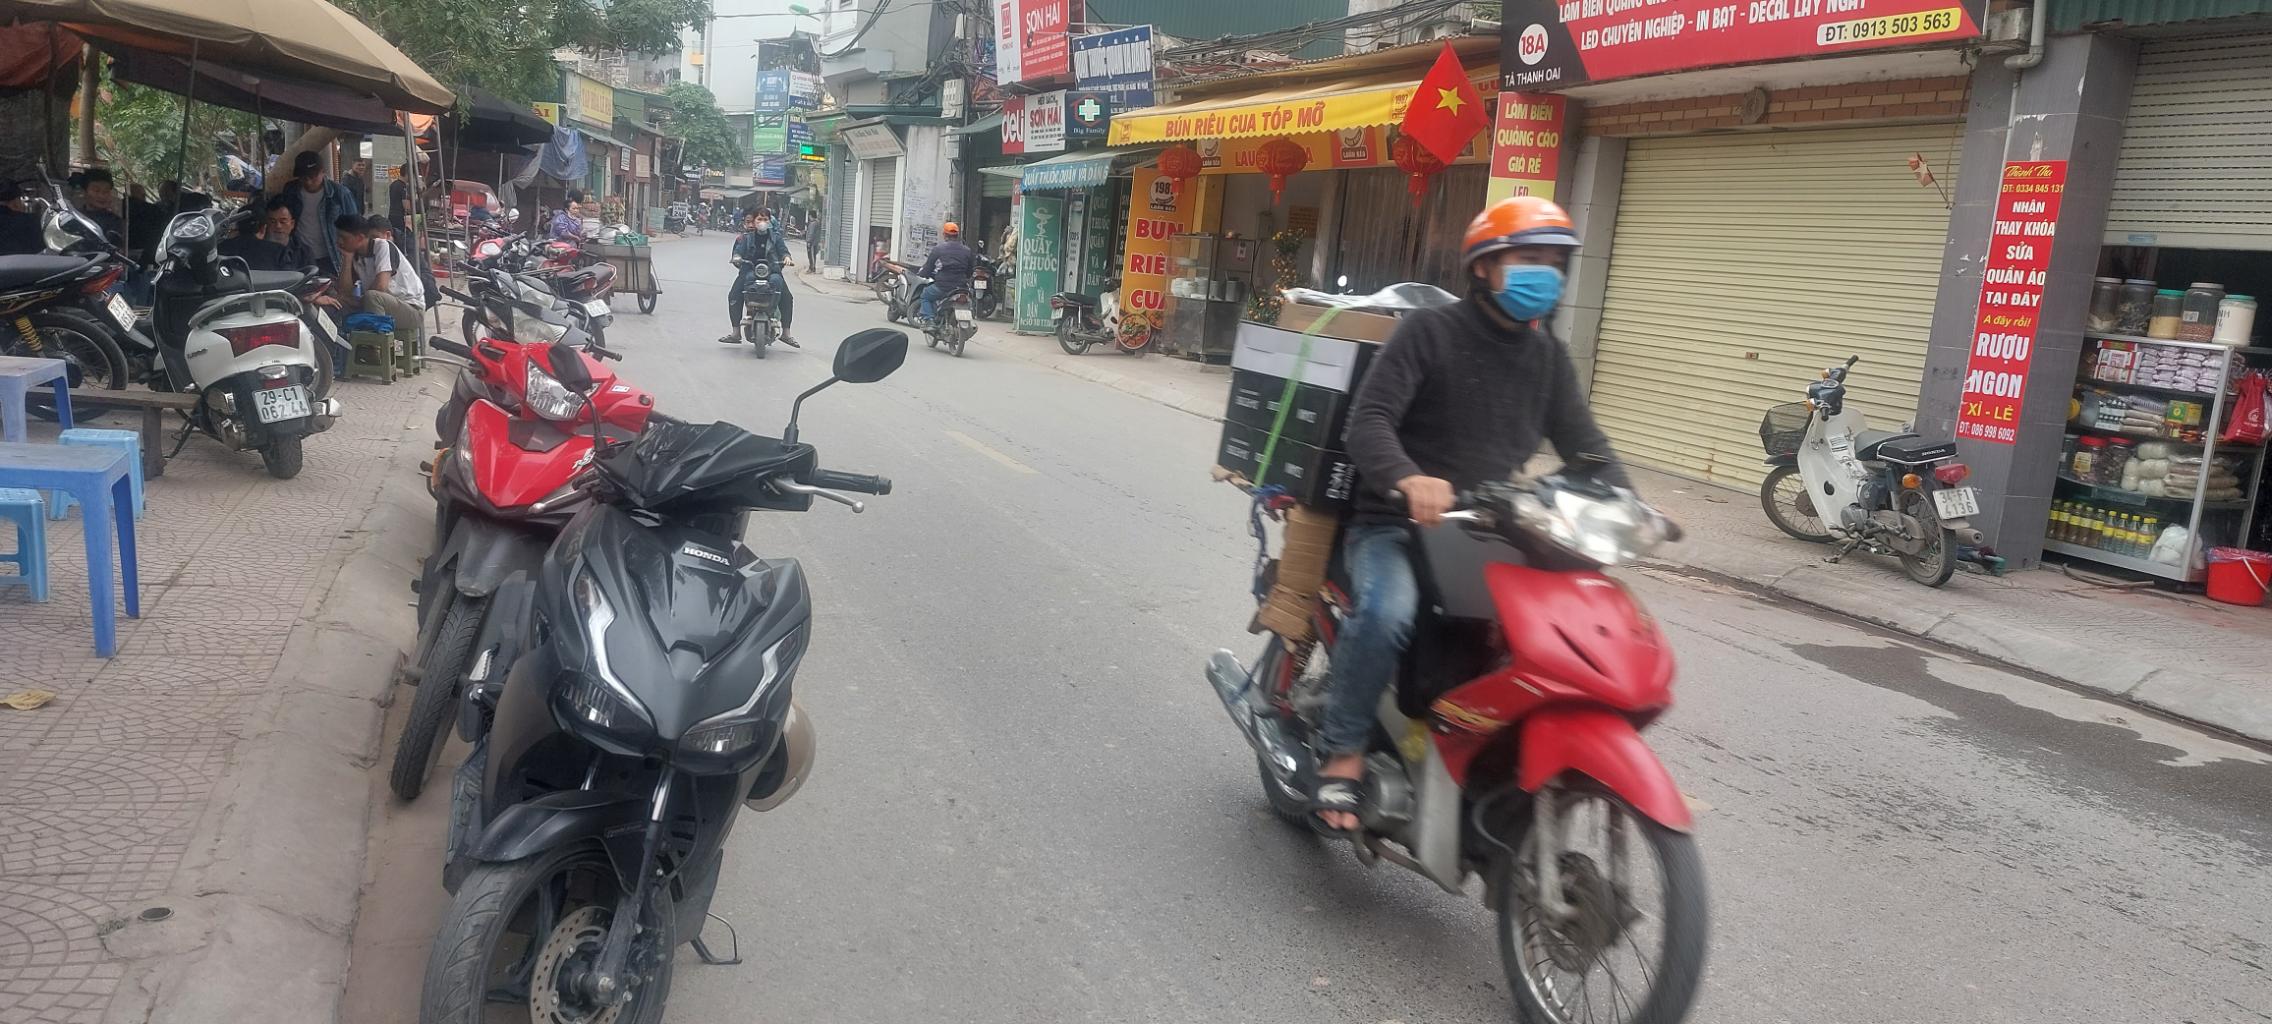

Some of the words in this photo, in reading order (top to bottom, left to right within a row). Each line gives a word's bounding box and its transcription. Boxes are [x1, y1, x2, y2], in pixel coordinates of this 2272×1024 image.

[1581, 29, 1599, 50] LED
[1601, 18, 1643, 47] CHUYÊN
[1644, 10, 1685, 40] NGHIỆP
[1696, 9, 1710, 32] IN
[1712, 5, 1737, 33] BẠT
[1747, 0, 1790, 24] DECAL
[1825, 25, 1848, 42] ĐT:
[1852, 17, 1887, 39] 0913
[1891, 16, 1918, 35] 503
[1922, 12, 1951, 31] 563
[1520, 33, 1546, 56] 18A
[1516, 69, 1544, 86] THANH
[1545, 66, 1561, 81] OAI
[1001, 109, 1025, 143] deli
[1165, 115, 1191, 138] BÚN
[1194, 112, 1226, 136] RIÊU
[1229, 113, 1256, 134] CUA
[1262, 106, 1293, 131] TÓP
[1155, 182, 1175, 196] 198
[2002, 184, 2015, 193] ĐT:
[2015, 184, 2034, 193] 0334
[2034, 184, 2049, 193] 845
[2051, 184, 2065, 193] 131
[2012, 199, 2046, 215] NHẬN
[1136, 217, 1184, 241] BÚN
[1995, 221, 2023, 236] THAY
[2024, 219, 2056, 237] KHÓA
[2006, 241, 2034, 260] SỬA
[2026, 267, 2047, 286] ÁO
[1985, 291, 2008, 307] TẠI
[2010, 291, 2041, 307] ĐÂY
[1975, 332, 2030, 365] RƯỢU
[1968, 369, 2023, 399] NGON
[261, 387, 299, 406] 29-C1
[1970, 423, 1984, 437] 086
[1997, 427, 2015, 442] 6092
[684, 547, 730, 566] HONDA
